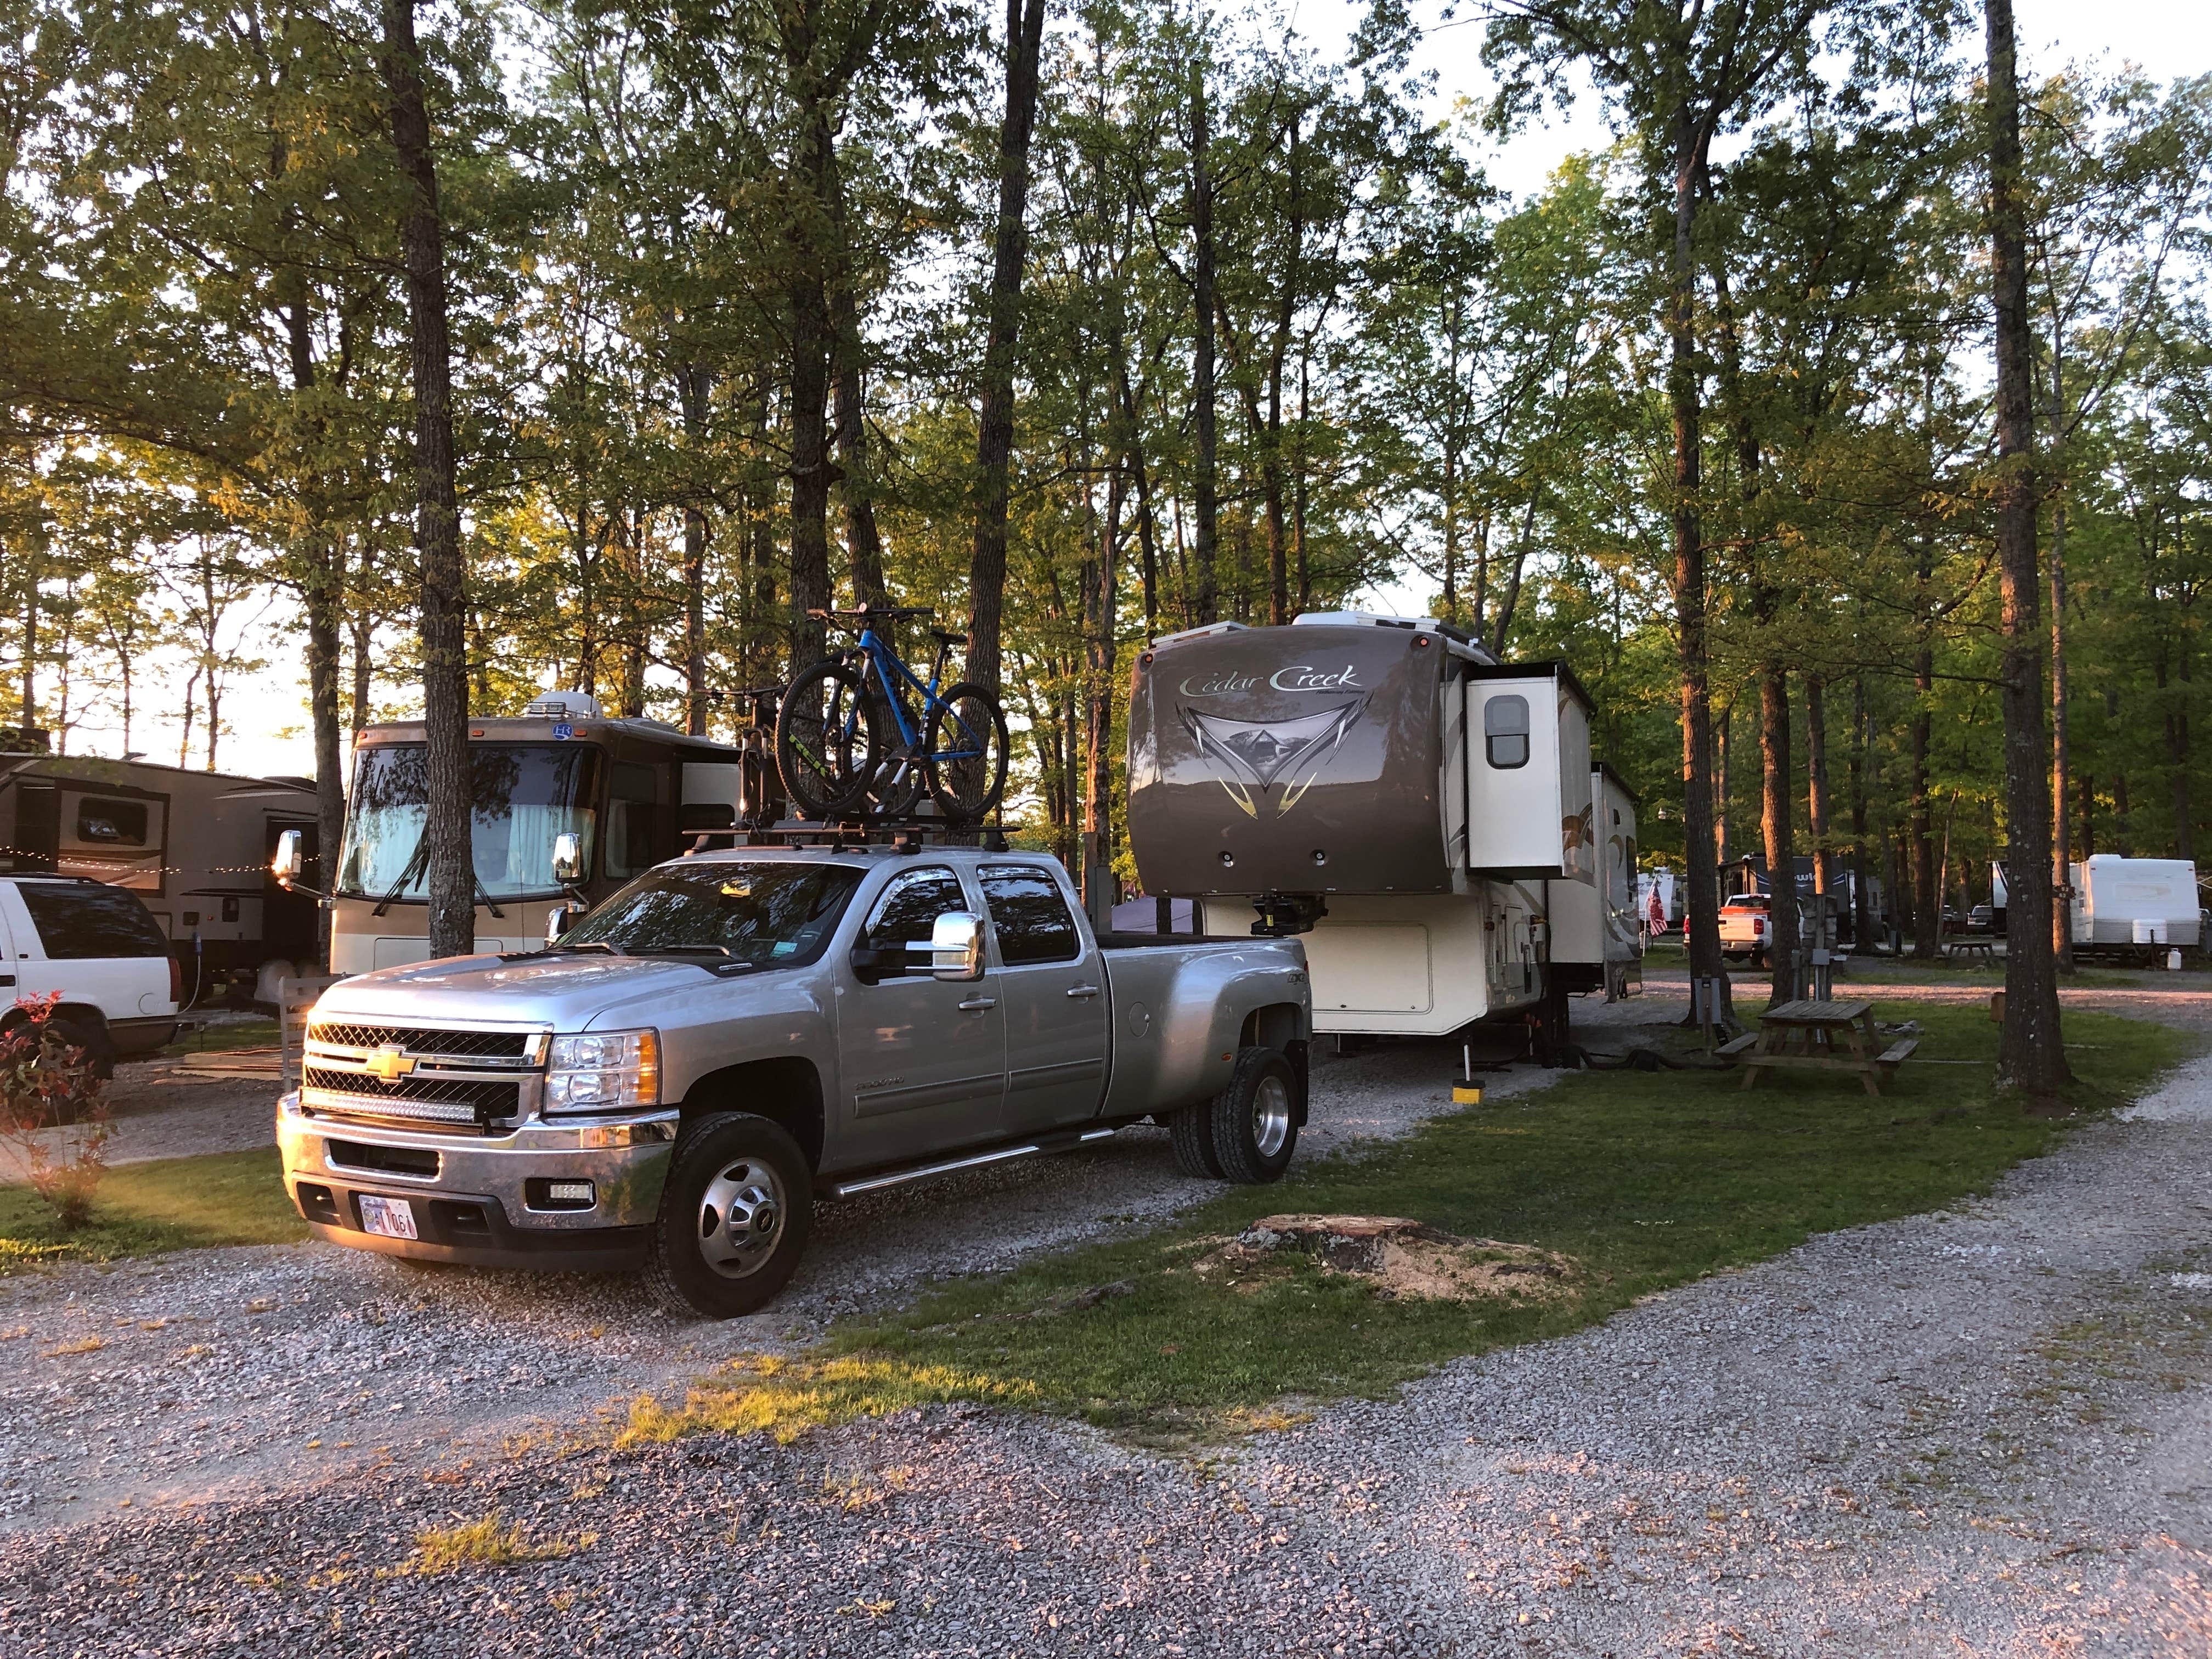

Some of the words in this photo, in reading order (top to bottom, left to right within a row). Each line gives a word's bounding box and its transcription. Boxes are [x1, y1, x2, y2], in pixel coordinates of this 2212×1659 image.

[1180, 670, 1264, 697] Cedar
[1269, 664, 1363, 691] Creek
[555, 726, 571, 734] HR
[380, 1211, 412, 1233] 11061
